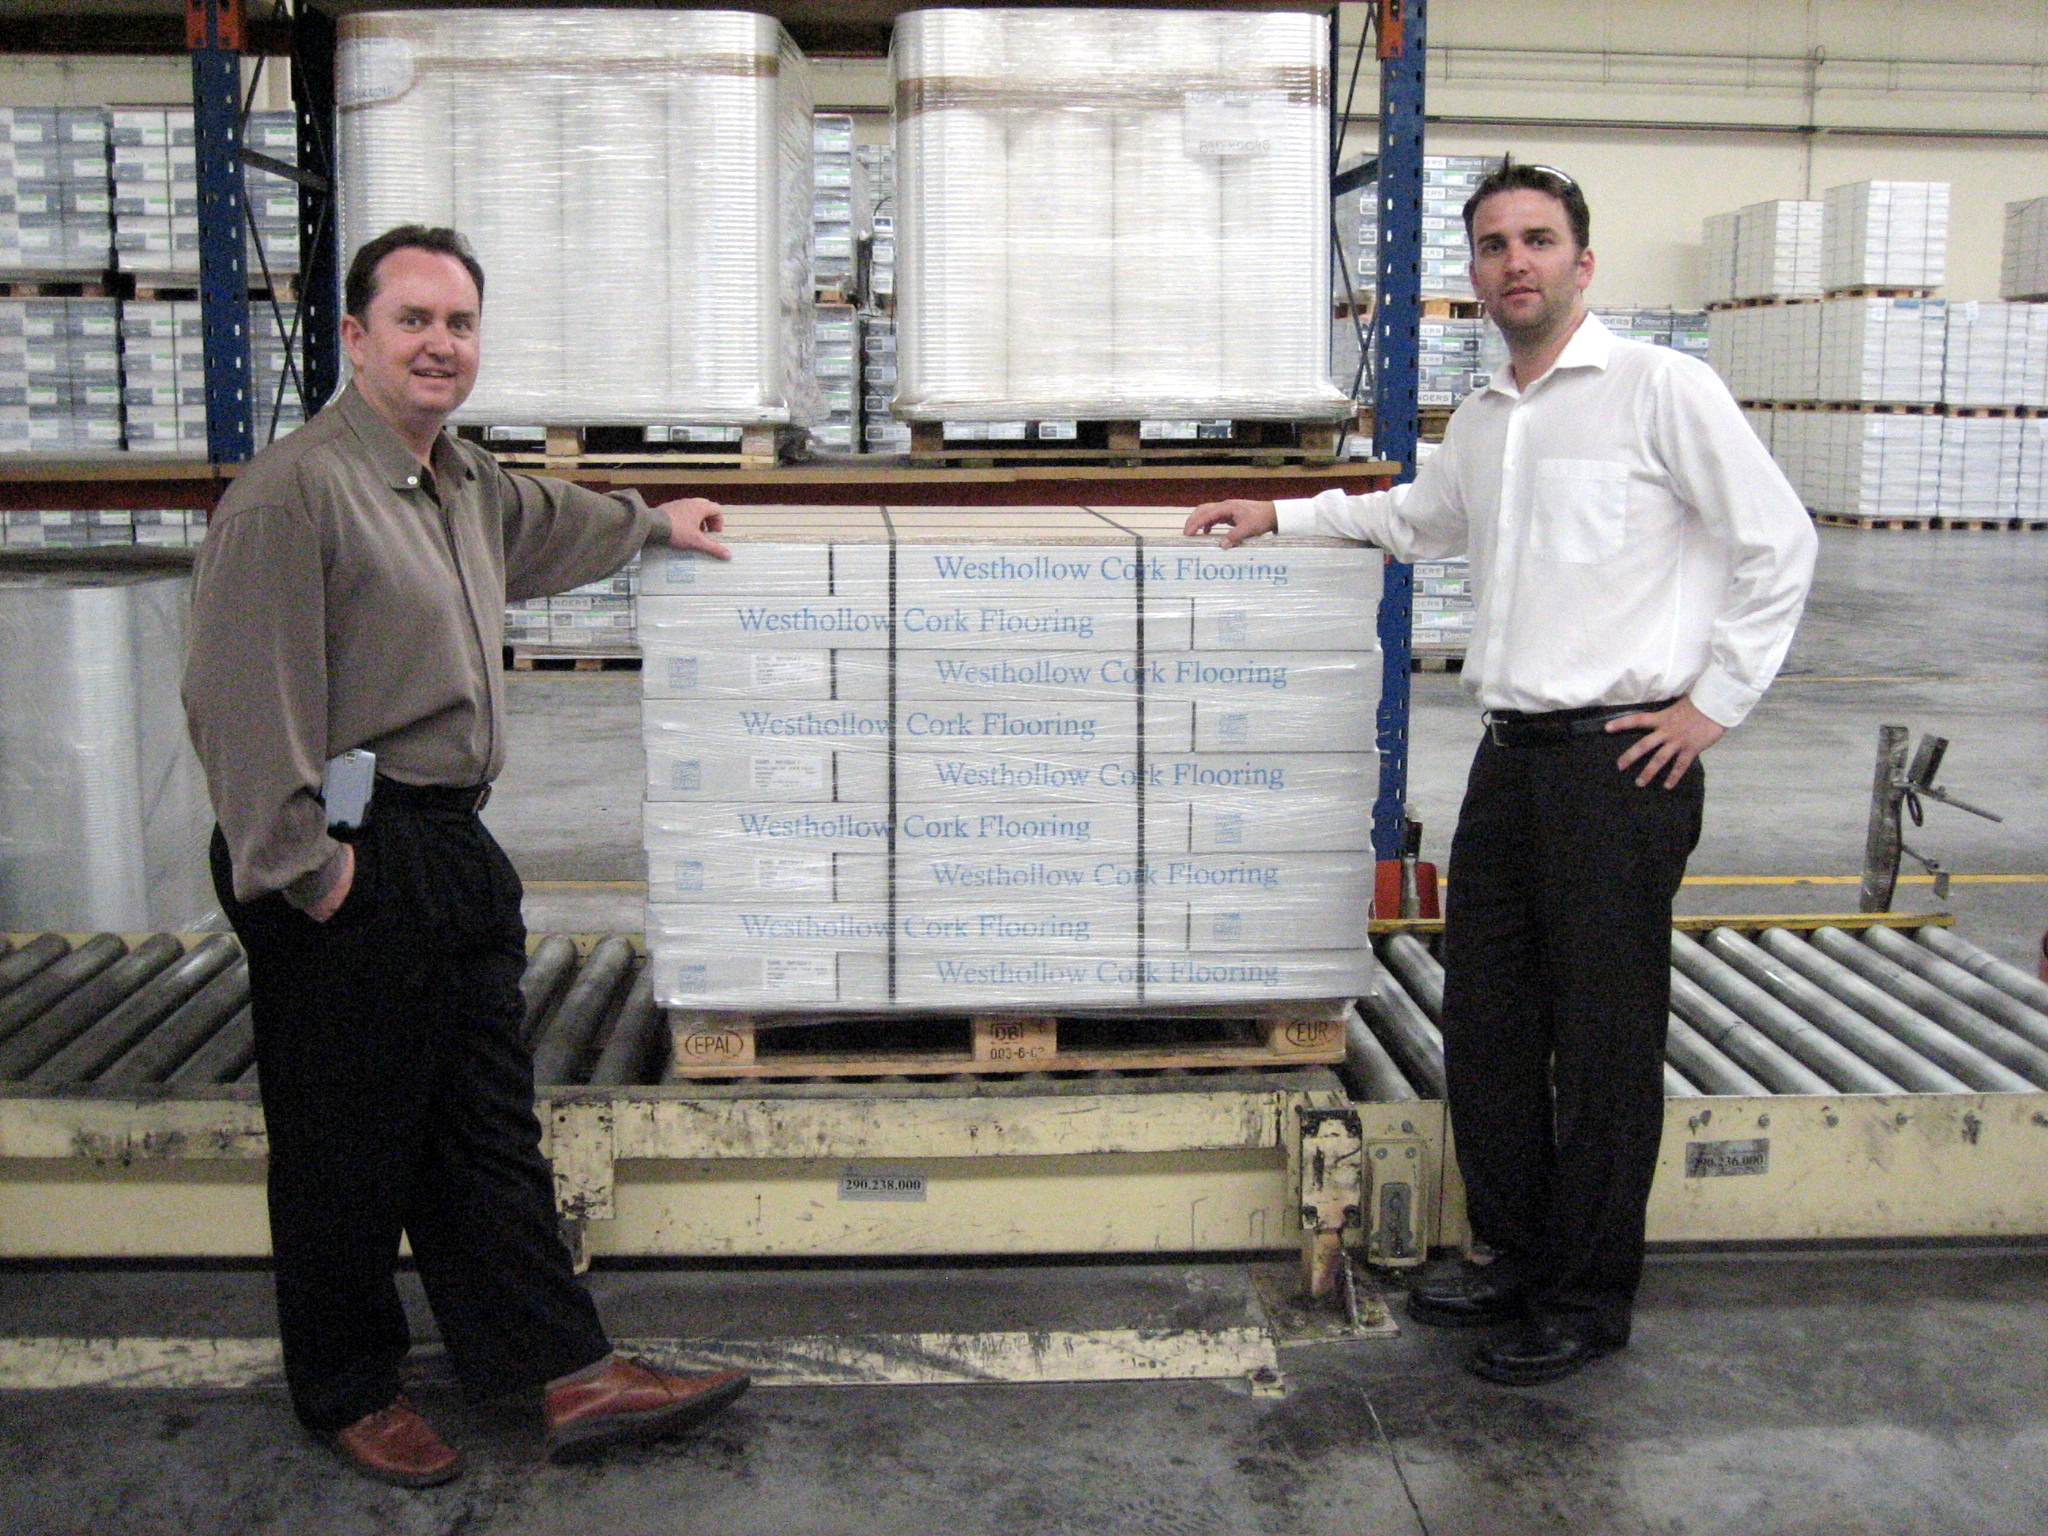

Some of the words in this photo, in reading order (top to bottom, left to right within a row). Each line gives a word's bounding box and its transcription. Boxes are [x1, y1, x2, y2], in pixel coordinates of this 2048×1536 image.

[934, 555, 1092, 581] Westhollow
[1174, 557, 1288, 586] Flooring
[903, 608, 969, 633] Cork
[980, 608, 1094, 639] Flooring
[935, 660, 1091, 684] Westhollow
[1174, 661, 1288, 689] Flooring
[906, 712, 972, 736] Cork
[983, 713, 1096, 741] Flooring
[936, 763, 1089, 786] Westhollow
[1172, 762, 1285, 790] Flooring
[903, 815, 968, 839] Cork
[979, 814, 1091, 842] Flooring
[931, 862, 1084, 887] Westhollow
[1168, 861, 1279, 889] Flooring
[903, 914, 967, 938] Cork
[978, 914, 1091, 942] Flooring
[936, 960, 1088, 985] Westhollow
[1170, 960, 1279, 988] Flooring
[1296, 1020, 1328, 1042] EUR
[845, 1179, 921, 1191] 290.238.000
